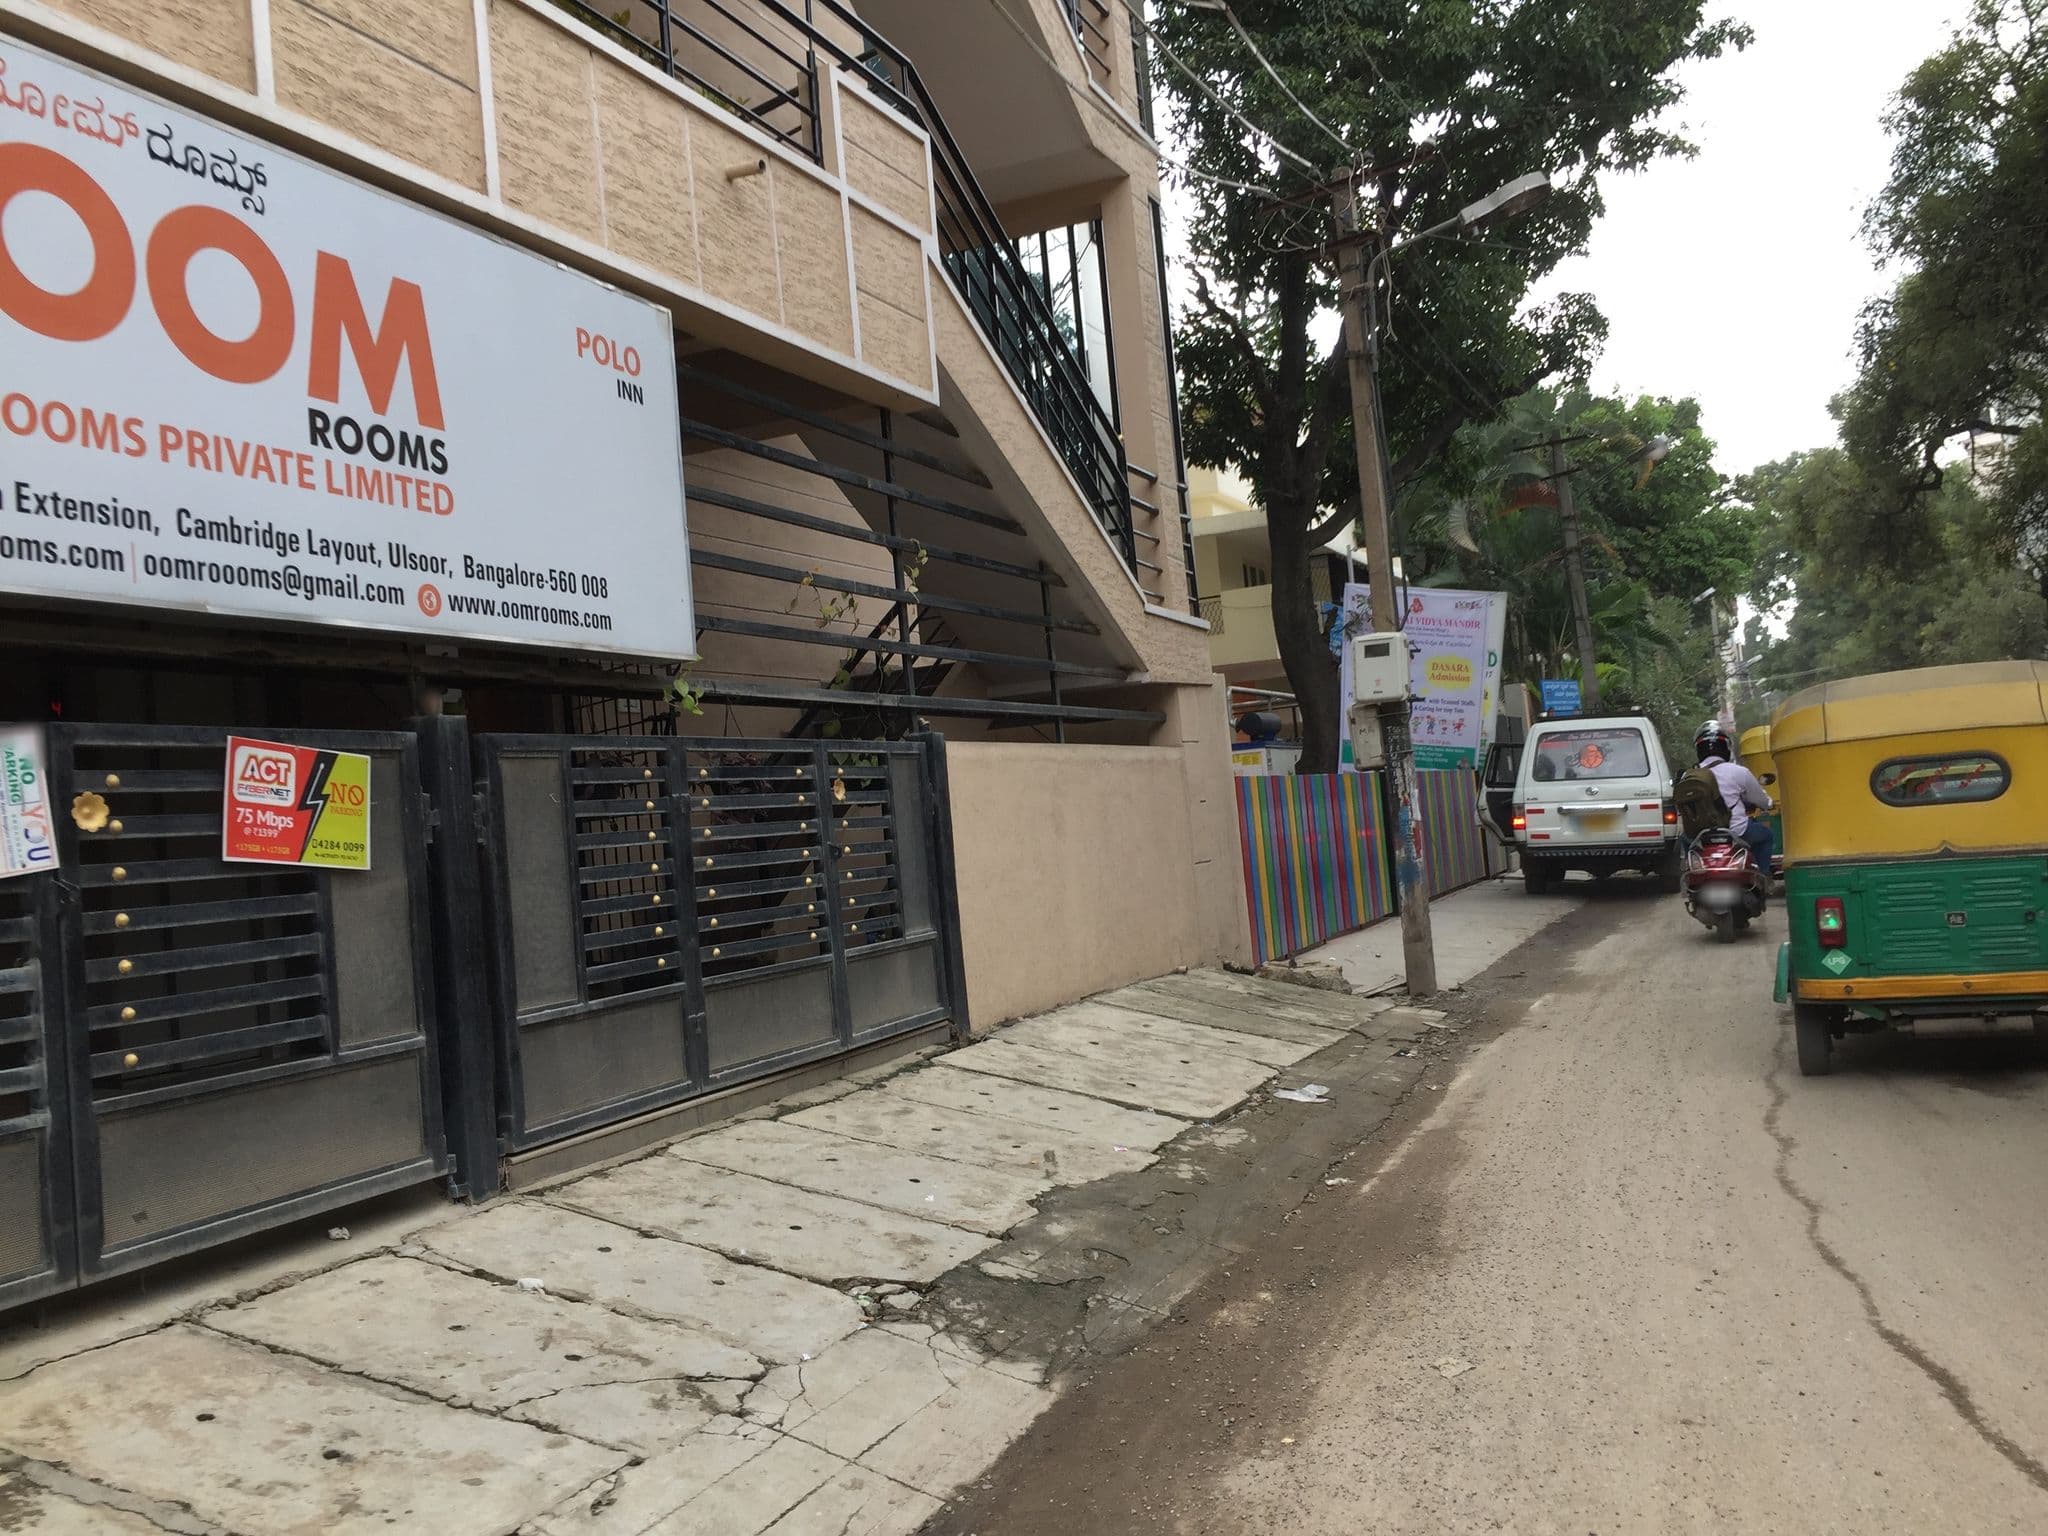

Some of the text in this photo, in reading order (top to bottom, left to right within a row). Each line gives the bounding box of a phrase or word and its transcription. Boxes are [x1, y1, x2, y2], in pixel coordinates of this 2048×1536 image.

[0, 142, 446, 431] OOM
[576, 326, 641, 377] POLO
[616, 378, 644, 406] INN
[158, 423, 317, 491] PRIVATE
[324, 458, 455, 517] LIMITED
[307, 407, 449, 476] ROOMS
[14, 480, 161, 537] Extension,
[176, 507, 301, 558] Cambridge
[306, 528, 382, 569] Layout,
[388, 541, 454, 579] Ulsoor,
[581, 573, 609, 600] 008
[143, 552, 406, 607] oomroooms@gmail.com
[447, 592, 613, 632] www.oomrooms.com
[5, 744, 21, 804] ARKING
[240, 755, 291, 786] ACT
[329, 782, 365, 807] NO
[20, 804, 51, 861] YOU
[235, 807, 294, 831] 75 Mbps
[1827, 955, 1847, 967] LPG
